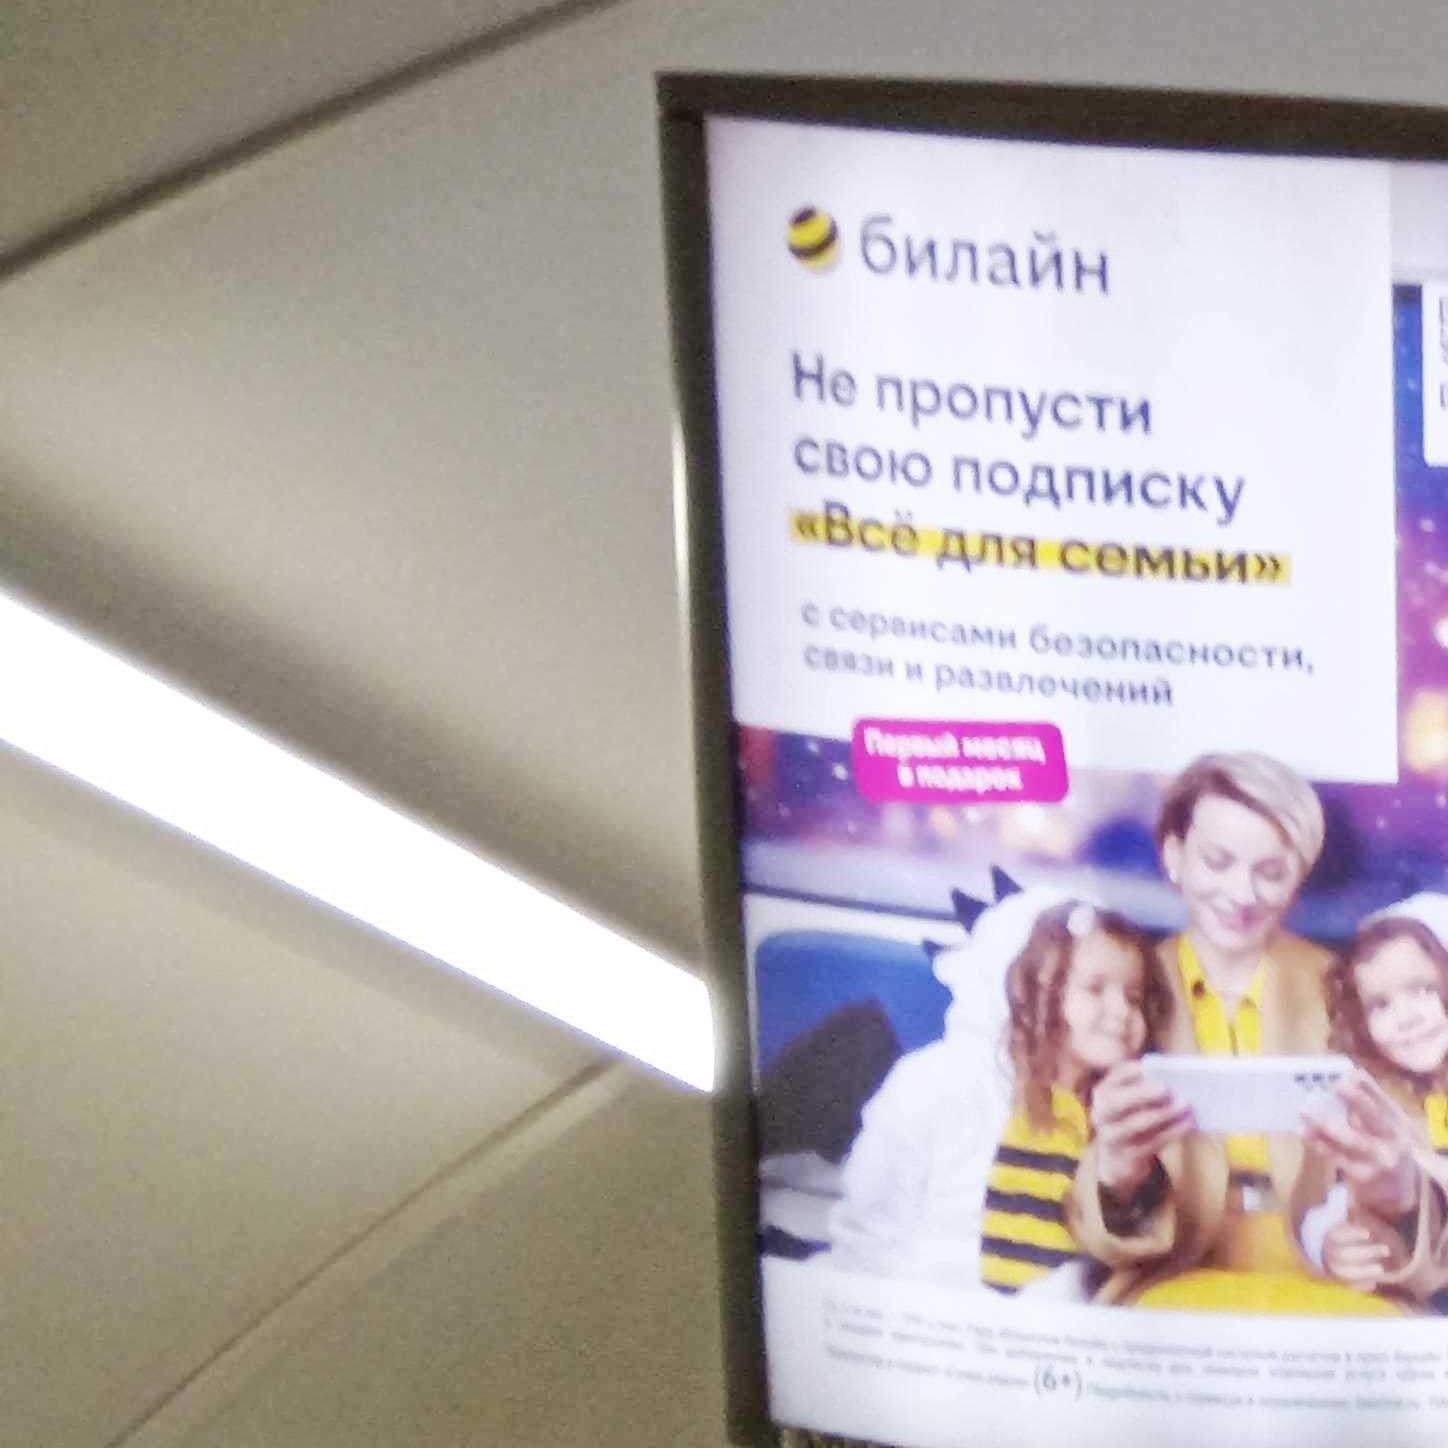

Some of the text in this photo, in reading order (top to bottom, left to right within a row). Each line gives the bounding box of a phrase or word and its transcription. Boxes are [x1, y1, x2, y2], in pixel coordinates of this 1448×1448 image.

[860, 214, 1110, 295] билайн
[792, 350, 1152, 440] Не пропусти
[793, 435, 1246, 526] свою подписку
[936, 528, 1038, 573] для
[801, 600, 821, 626] с
[829, 605, 1018, 651] сервисами
[906, 658, 924, 682] и
